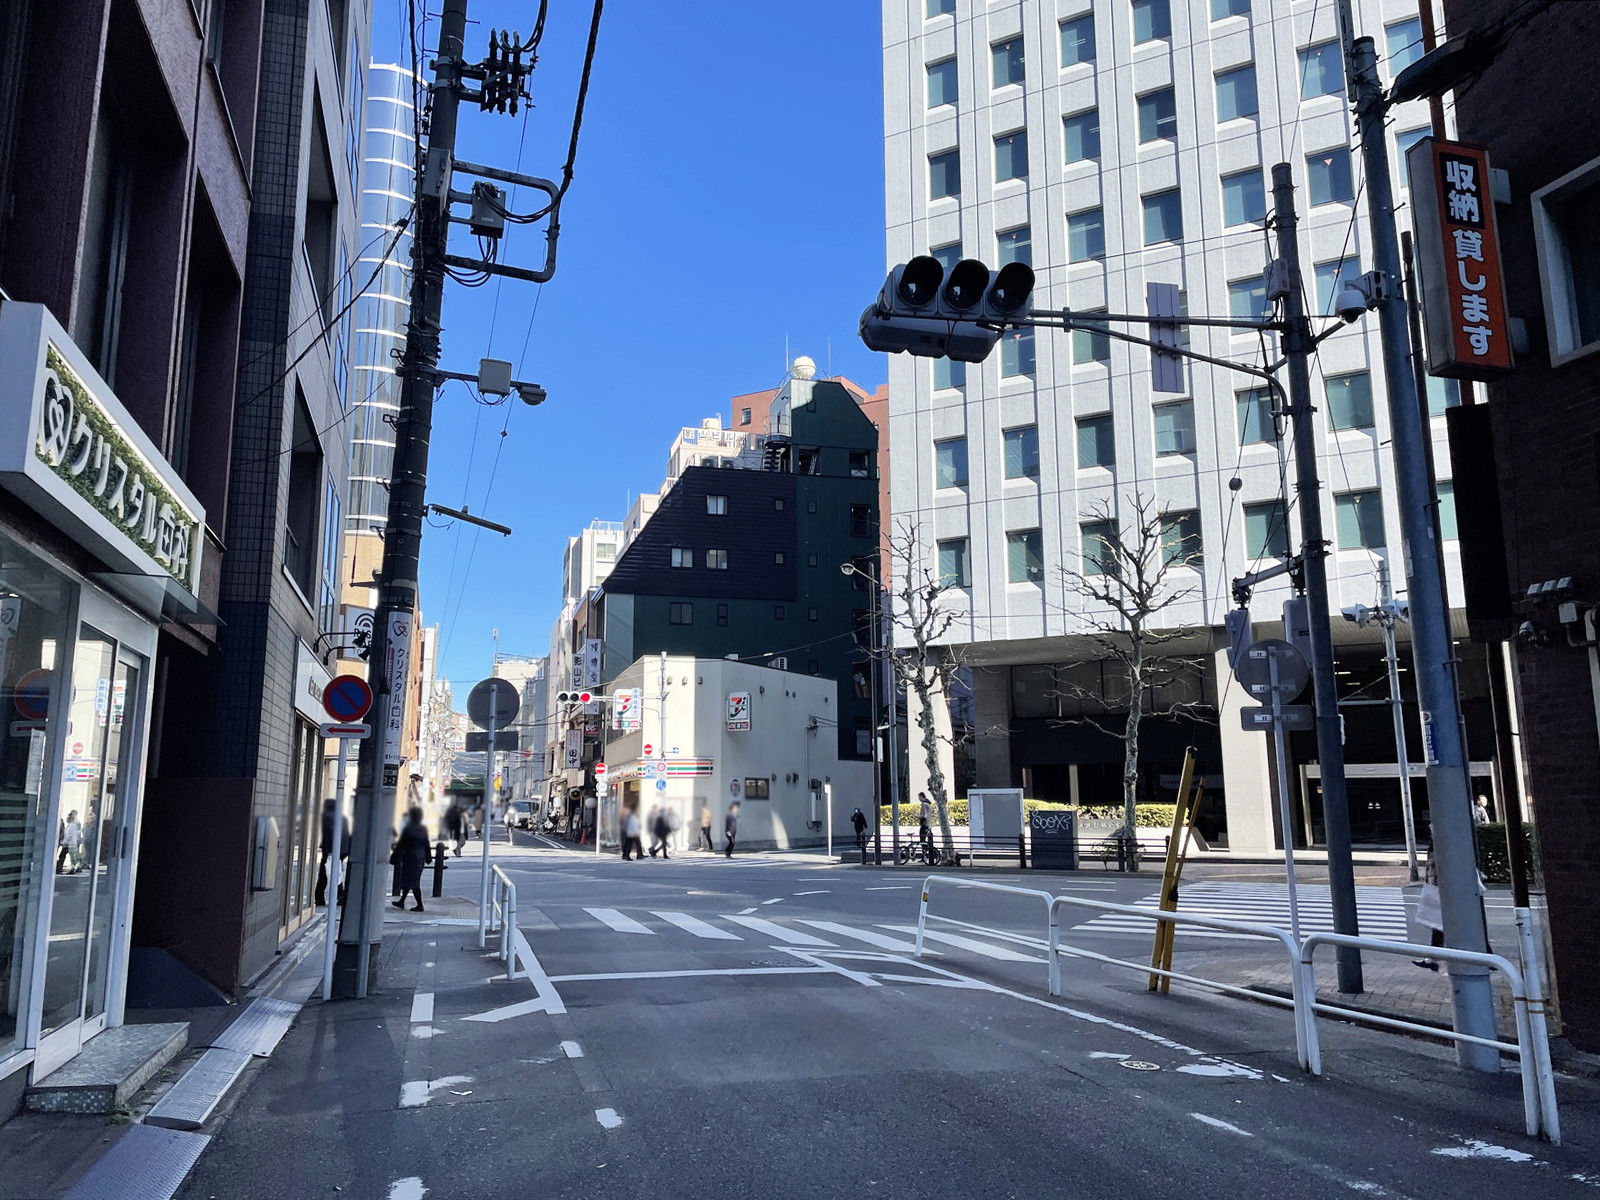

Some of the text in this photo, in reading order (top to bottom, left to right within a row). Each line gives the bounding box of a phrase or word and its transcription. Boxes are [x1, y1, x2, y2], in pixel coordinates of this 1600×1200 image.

[684, 429, 734, 441] 影山ビル
[70, 412, 192, 580] クリスタル歯科
[389, 648, 405, 731] クリスタル歯科
